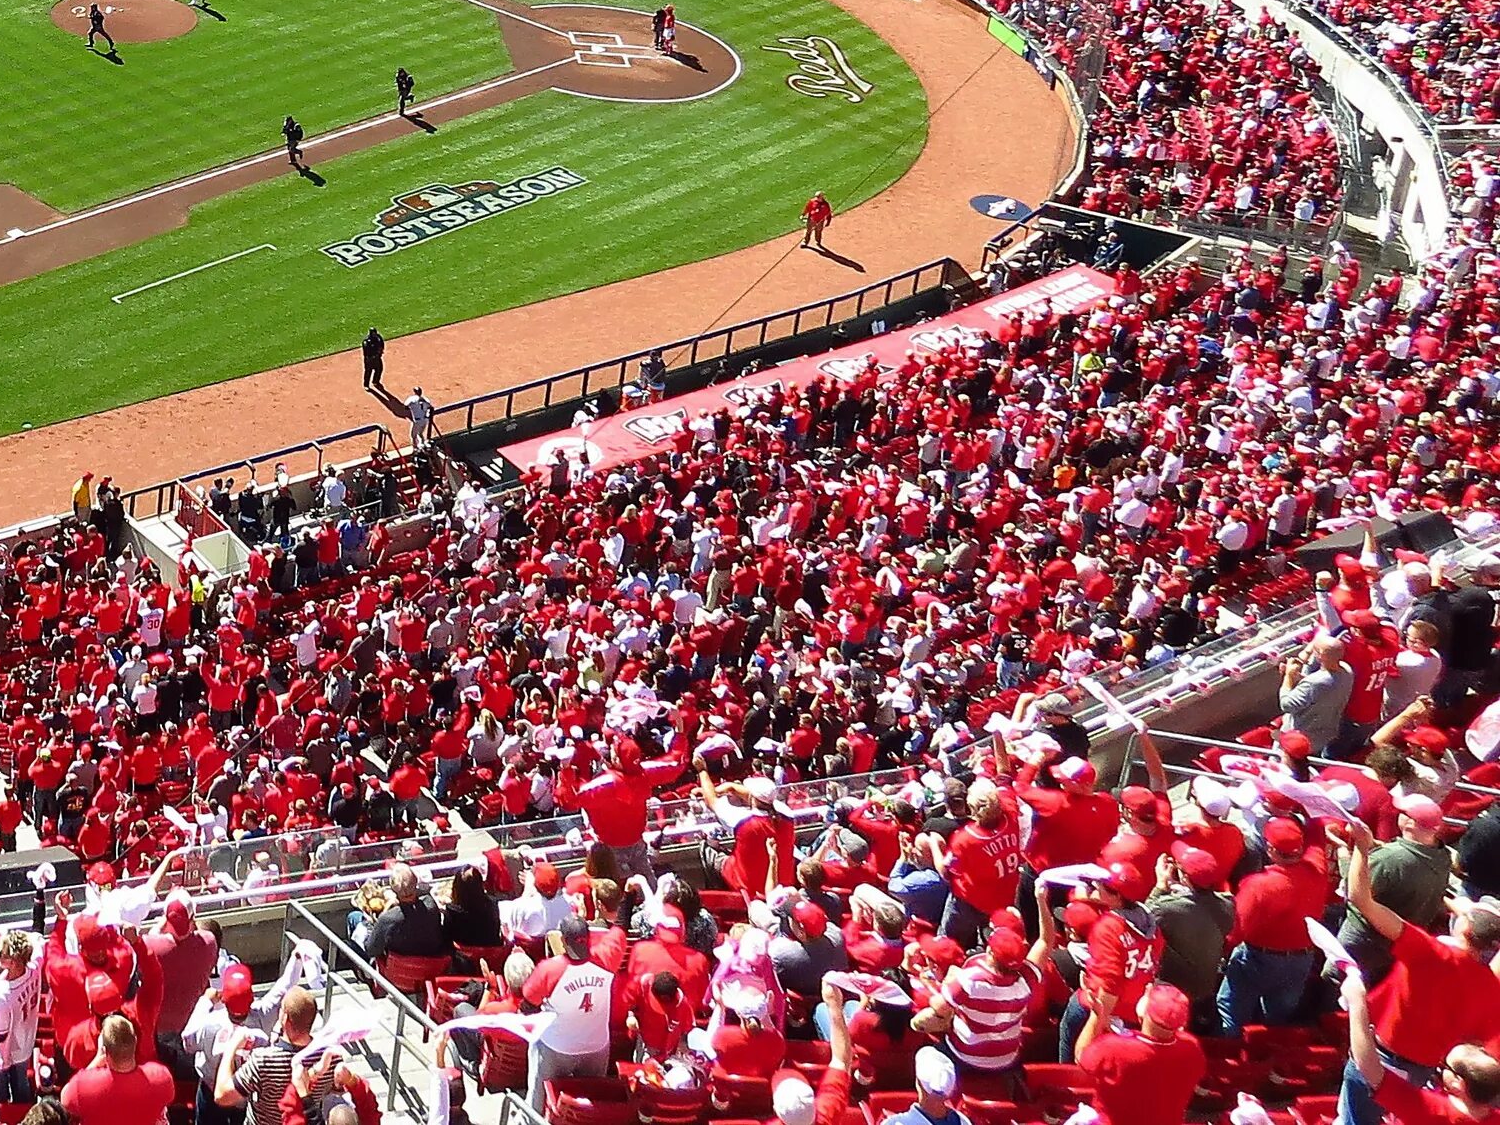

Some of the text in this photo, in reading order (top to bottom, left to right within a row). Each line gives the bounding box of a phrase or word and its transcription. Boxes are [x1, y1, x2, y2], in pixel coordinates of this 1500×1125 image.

[761, 35, 874, 103] Reds
[328, 169, 582, 266] POSTSEASON
[147, 618, 160, 630] 30
[982, 832, 1018, 858] VOTTO
[994, 852, 1019, 878] 19
[1124, 944, 1155, 979] 54
[563, 976, 605, 994] PHILLIPS
[578, 992, 594, 1013] 4
